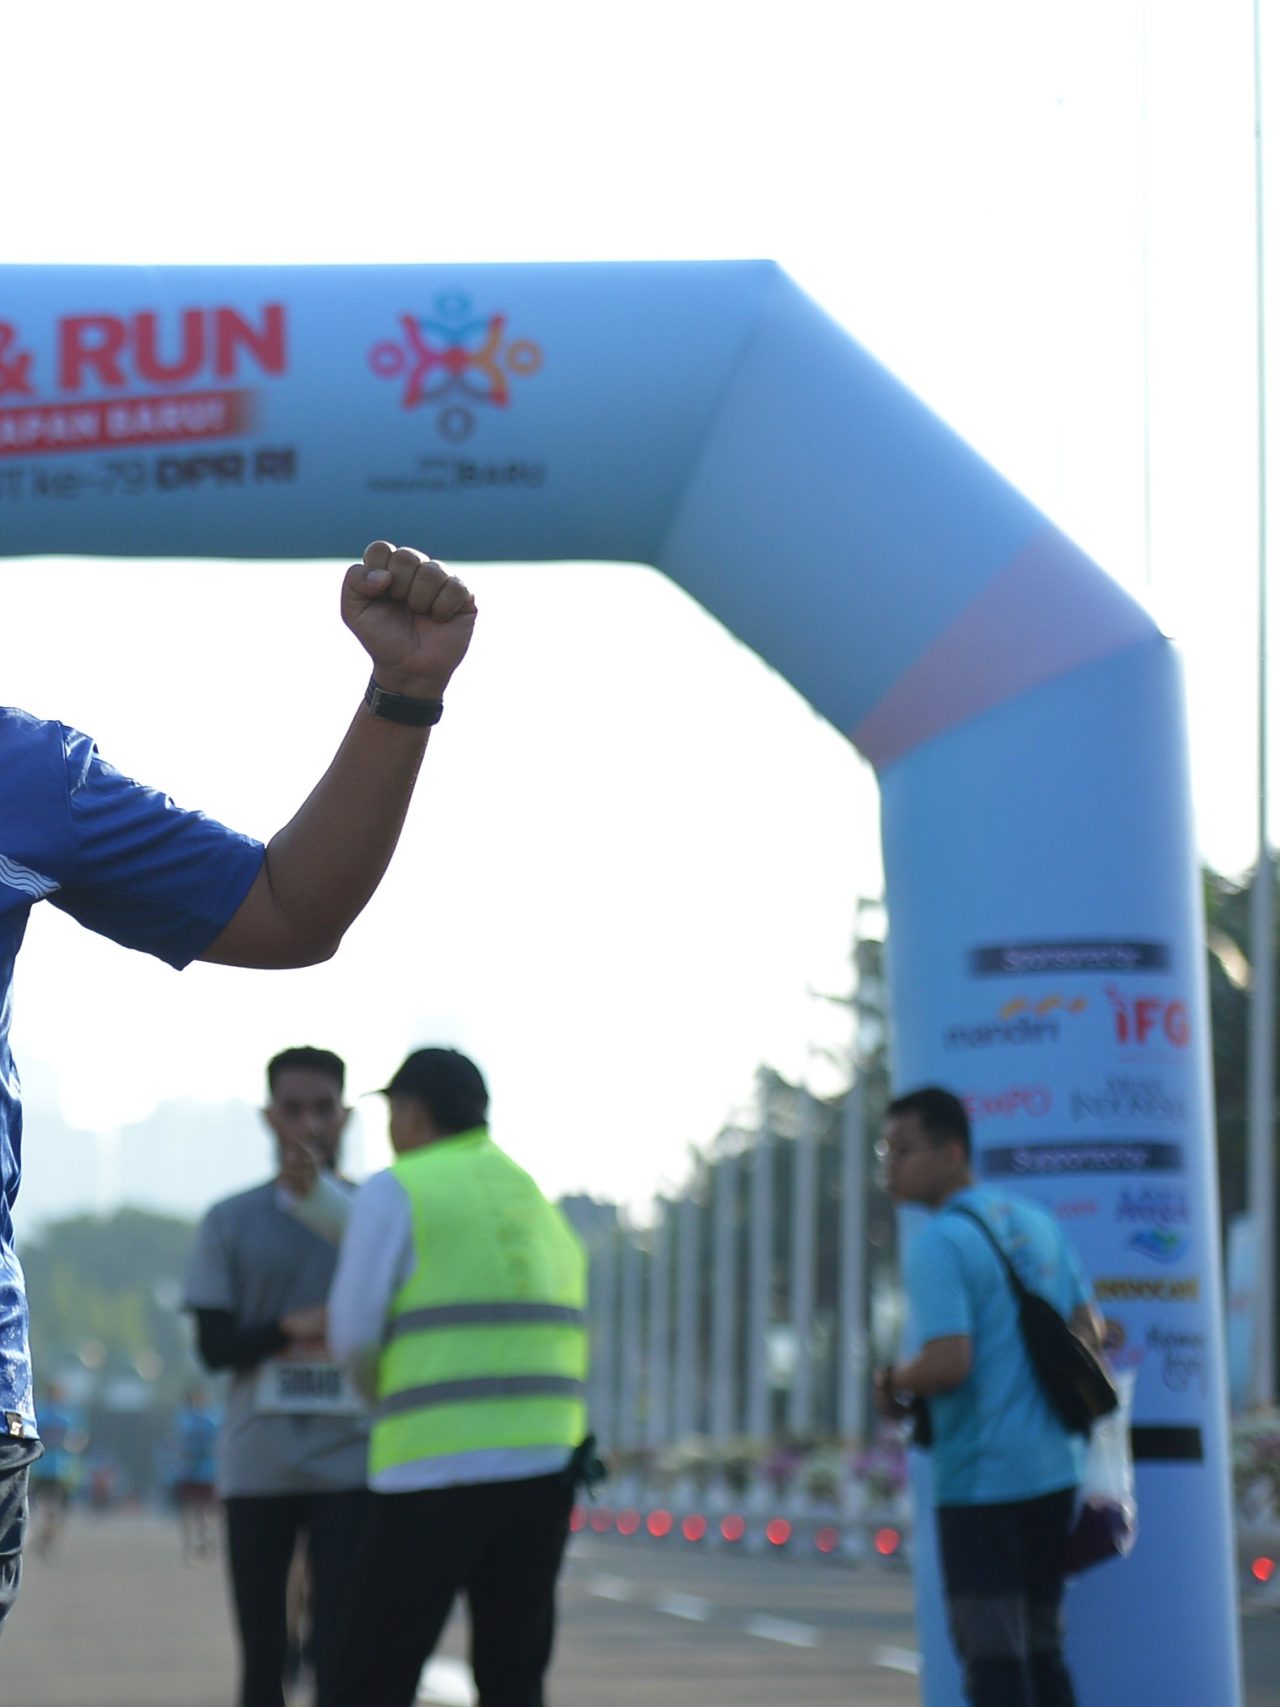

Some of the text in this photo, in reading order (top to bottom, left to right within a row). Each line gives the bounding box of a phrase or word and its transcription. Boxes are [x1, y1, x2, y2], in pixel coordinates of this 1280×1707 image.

[57, 303, 287, 392] RUN
[157, 451, 245, 491] DPR
[254, 448, 297, 483] RI
